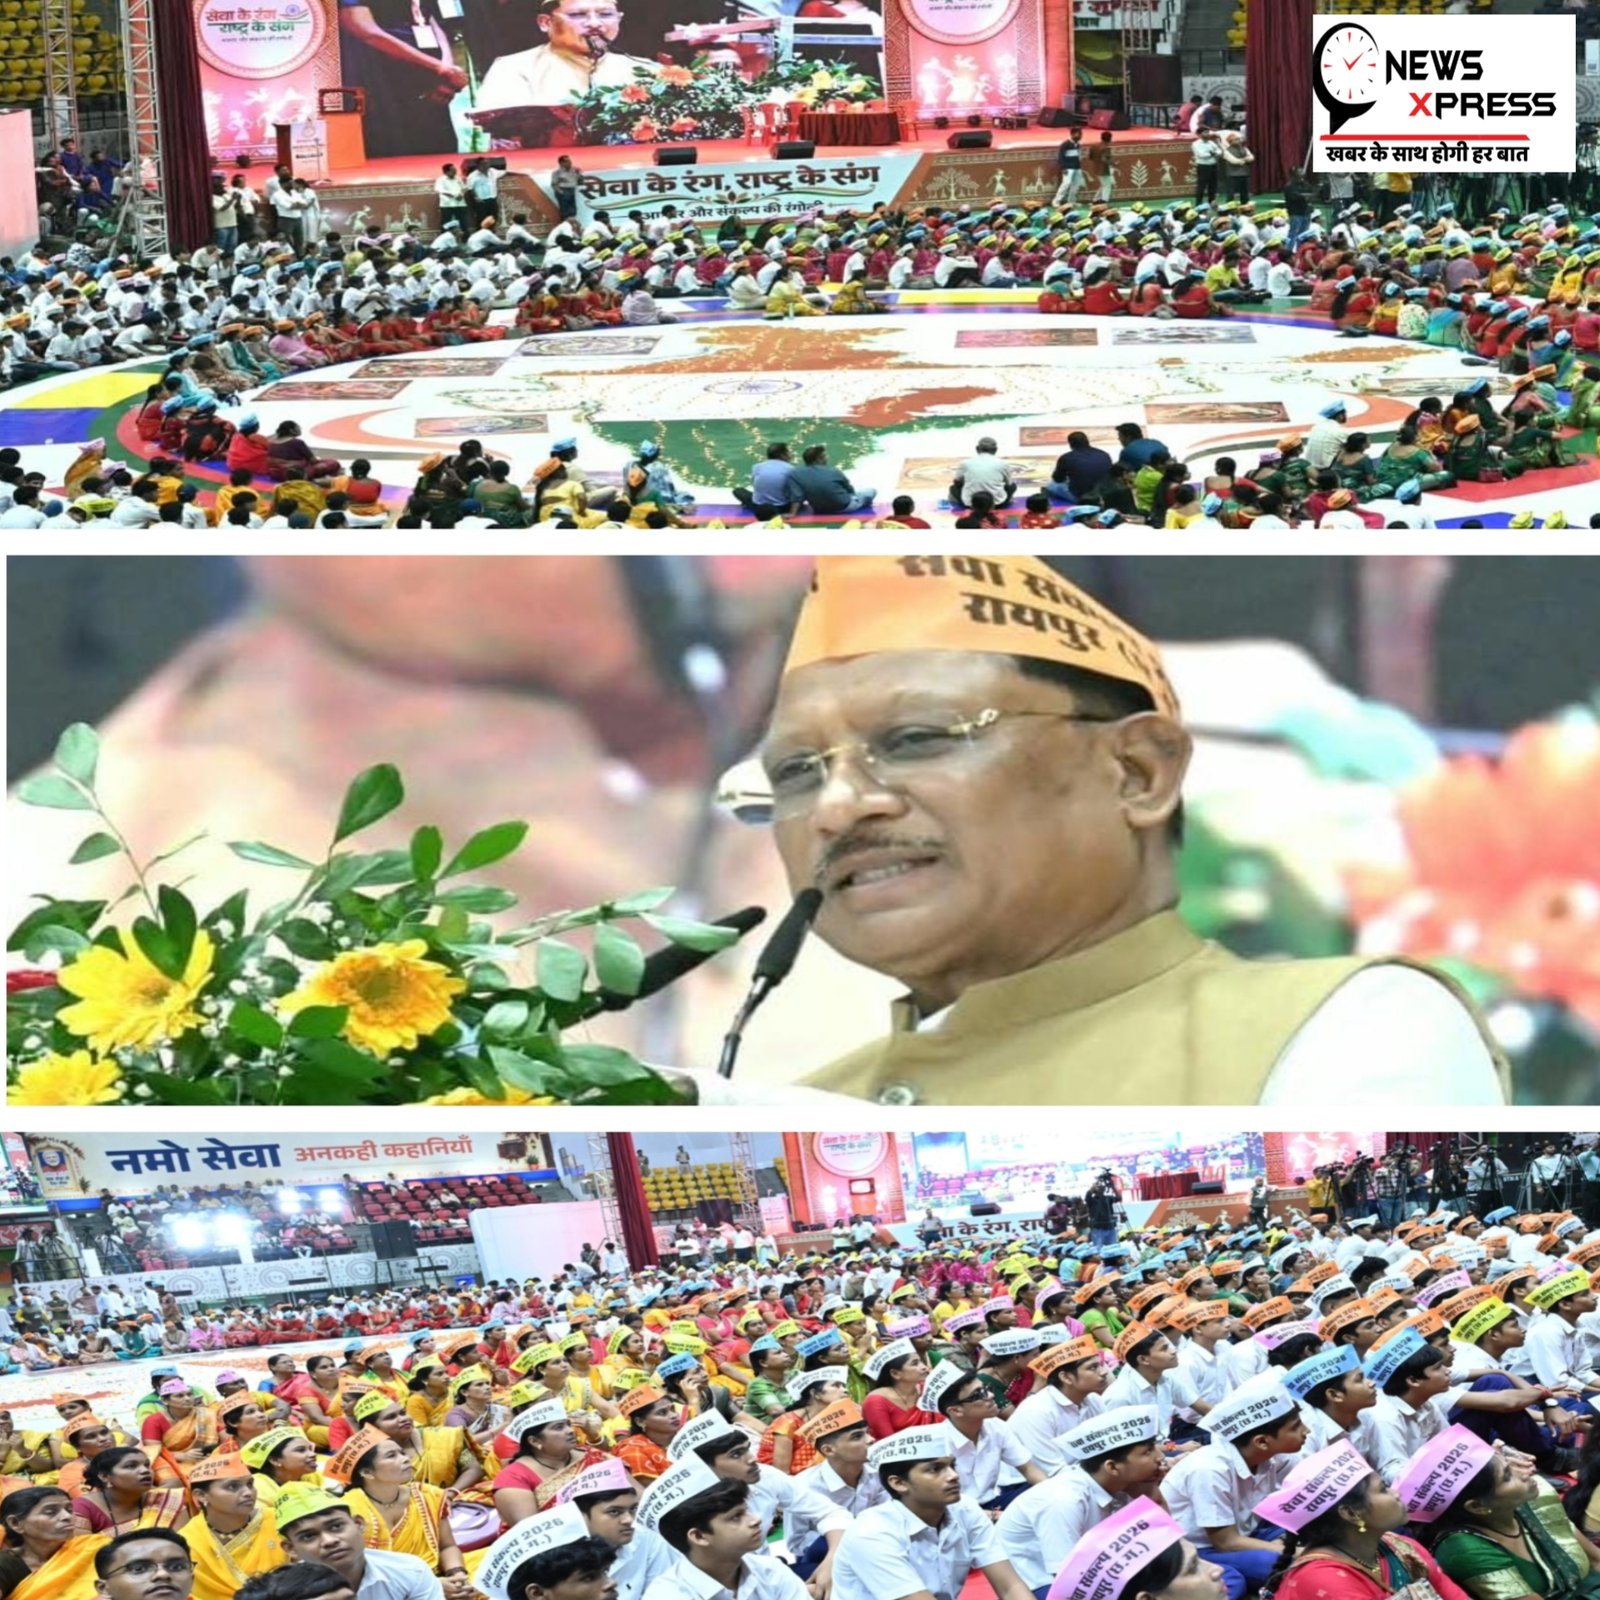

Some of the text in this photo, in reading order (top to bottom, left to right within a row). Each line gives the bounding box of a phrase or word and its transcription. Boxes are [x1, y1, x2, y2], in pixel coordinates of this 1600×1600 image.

[579, 172, 640, 199] सेवा
[645, 172, 677, 193] के
[734, 170, 794, 192] राष्ट्र
[795, 165, 825, 185] के
[829, 161, 880, 186] संग
[689, 204, 714, 218] और
[716, 202, 760, 217] संकल्प
[762, 201, 782, 215] की
[959, 592, 1106, 652] रायपुर
[106, 1138, 281, 1175] नमो सेवा
[294, 1134, 474, 1163] अनकही कहानियाँ
[958, 1221, 978, 1237] के
[1320, 1354, 1348, 1371] 2026
[821, 1408, 847, 1424] 2026
[1220, 1409, 1249, 1430] संकल्प
[1247, 1395, 1279, 1413] 2026
[687, 1418, 714, 1437] 2026
[898, 1434, 933, 1446] 2026
[1085, 1424, 1119, 1444] संकल्प
[1120, 1415, 1151, 1431] 2026
[581, 1468, 612, 1483] 2026
[657, 1468, 692, 1493] 2026
[1413, 1470, 1443, 1500] संकल्प
[1438, 1442, 1469, 1472] 2026
[1438, 1460, 1473, 1493] (छ.ग.)
[1278, 1488, 1308, 1514] सेवा
[1303, 1464, 1334, 1495] संकल्प
[1303, 1485, 1338, 1513] रायपुर
[491, 1538, 519, 1570] संकल्प
[521, 1517, 565, 1541] 2026
[510, 1533, 552, 1563] (छ.ग.)
[1080, 1550, 1112, 1588] संकल्प
[1108, 1519, 1151, 1553] 2026
[1105, 1541, 1150, 1580] (छ.ग.)
